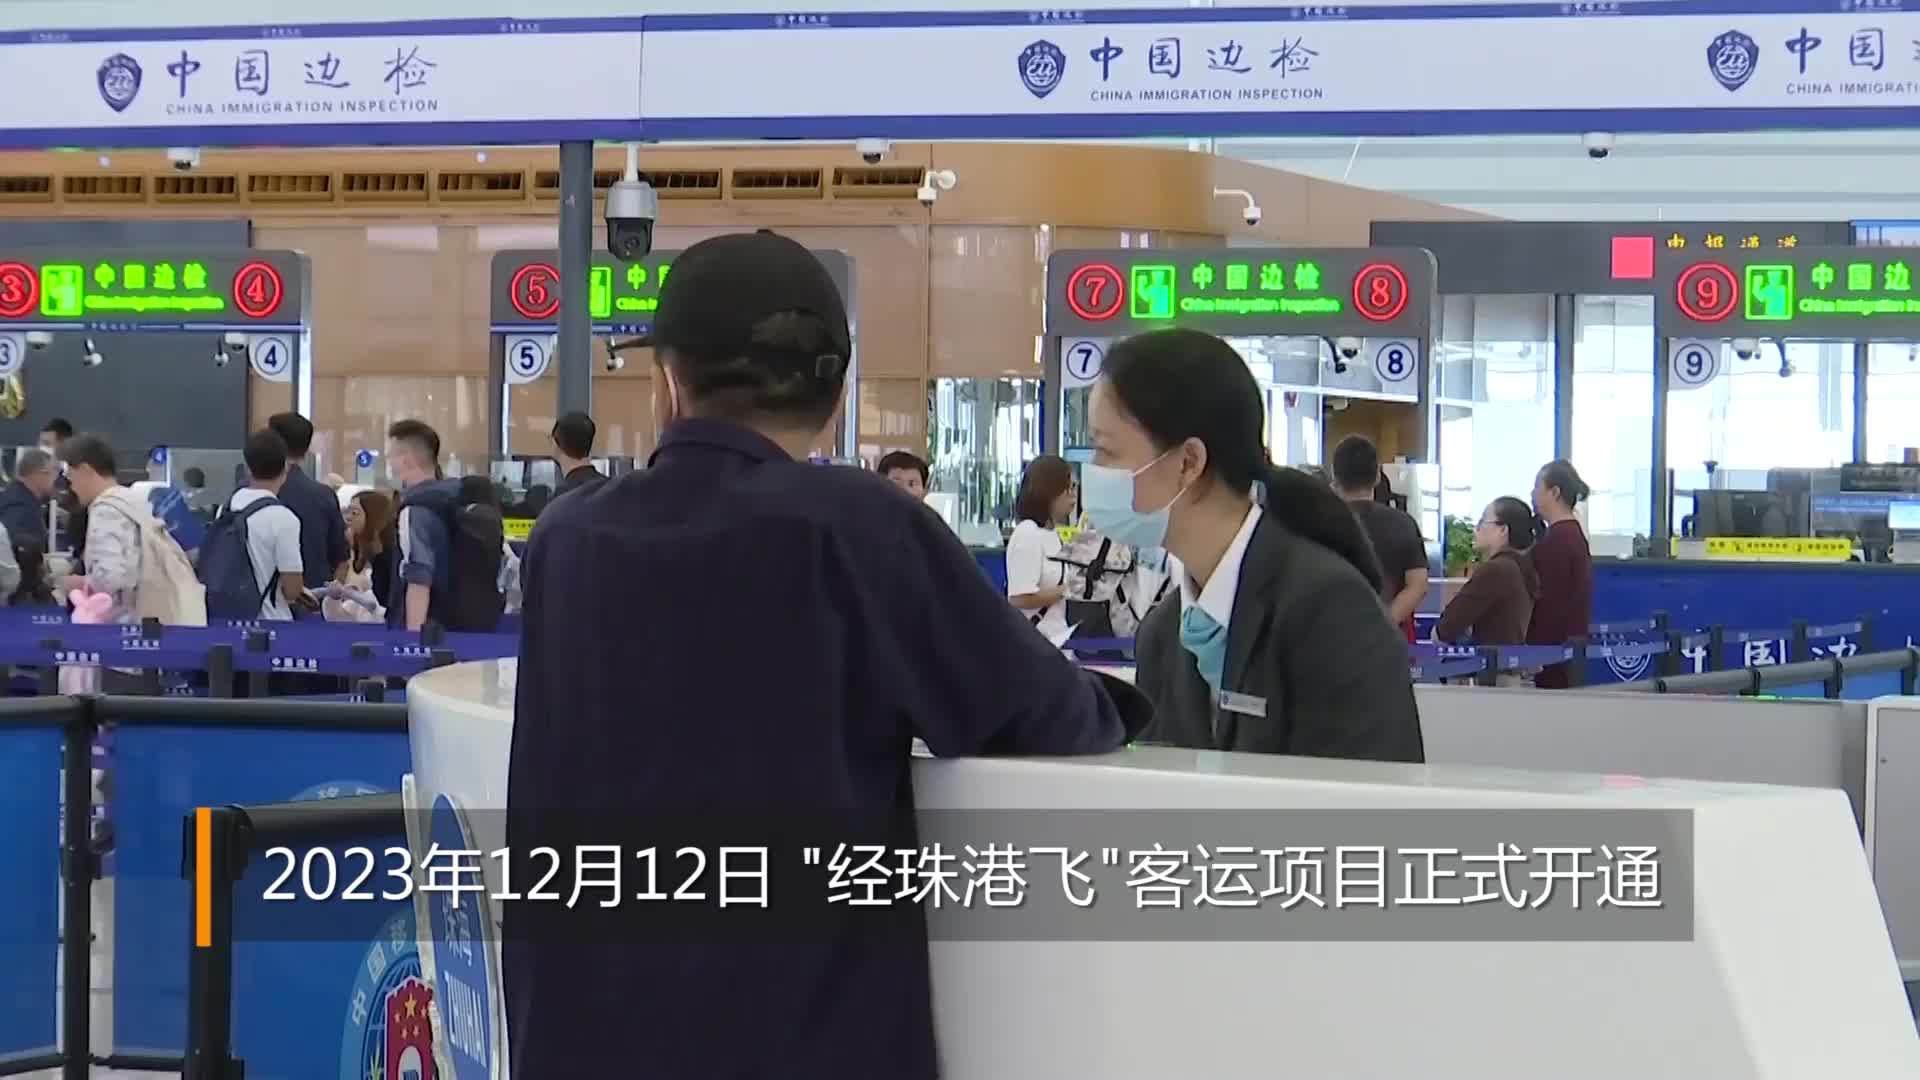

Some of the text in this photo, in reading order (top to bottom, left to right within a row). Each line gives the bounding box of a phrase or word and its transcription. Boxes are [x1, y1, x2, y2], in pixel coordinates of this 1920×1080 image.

[1090, 36, 1319, 81] 中国边检
[1785, 27, 1920, 74] 中国
[166, 46, 437, 98] 中国边检
[1090, 87, 1323, 101] CHINA IMMIGRATION INSPECTION
[1786, 81, 1920, 95] CHINA IMMIGRATI
[166, 99, 438, 115] CHINA IMMIGRATION INSPECTION
[1192, 263, 1320, 291] 中国边检
[1812, 262, 1910, 291] 中国边
